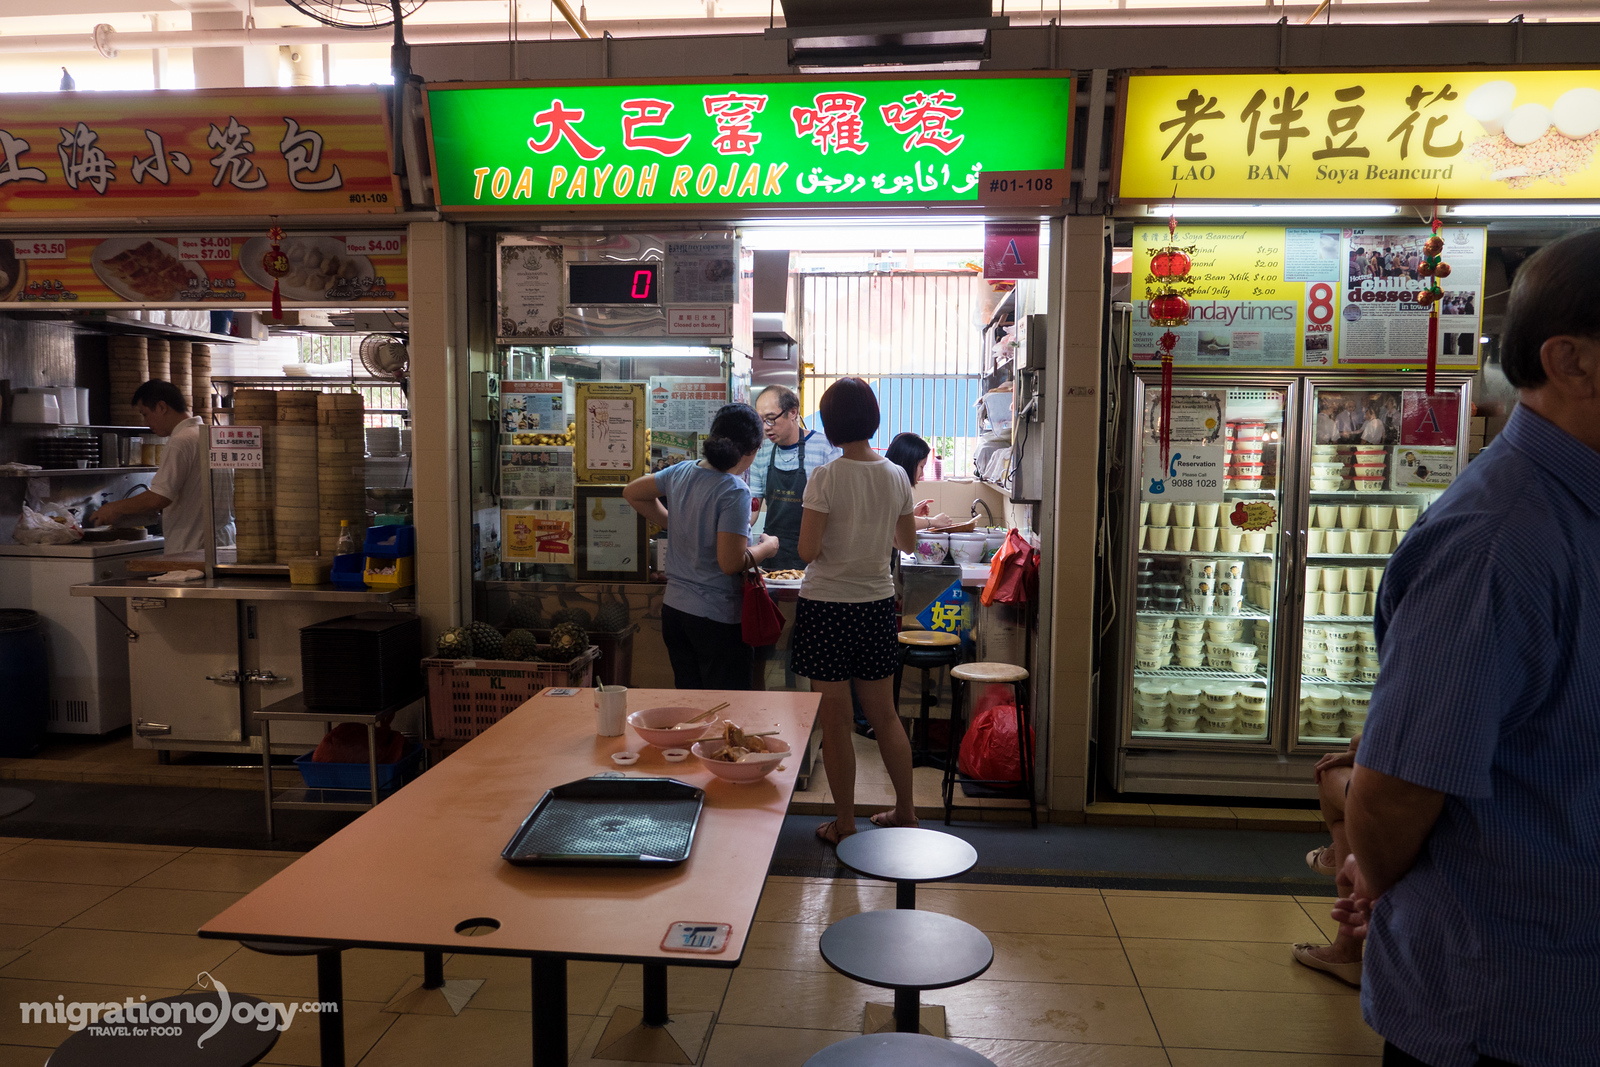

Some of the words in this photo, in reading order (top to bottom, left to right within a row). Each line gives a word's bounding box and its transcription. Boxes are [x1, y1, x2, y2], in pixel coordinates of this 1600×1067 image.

[1159, 83, 1464, 163] 老伴豆花
[1171, 165, 1216, 181] LAO
[1246, 165, 1291, 180] BAN
[1315, 164, 1359, 184] Soya
[1364, 164, 1453, 181] Beancurd
[474, 166, 533, 200] TOA
[548, 163, 659, 199] PAYOH
[670, 161, 789, 197] ROJAK
[989, 178, 1053, 193] #01-108
[348, 194, 388, 204] #01-109
[182, 240, 198, 248] 5pcs
[200, 237, 230, 248] $4.00
[1182, 232, 1203, 244] Soya
[1206, 231, 1247, 241] Beancurd
[15, 247, 31, 255] 5pcs
[33, 243, 64, 254] $3.50
[347, 244, 366, 252] 10pcs
[368, 240, 399, 251] $4.00
[997, 238, 1025, 265] A
[1256, 246, 1279, 255] $1.50
[180, 252, 198, 260] 10pcs
[201, 249, 230, 259] $7.00
[1254, 260, 1278, 268] $2.00
[1204, 273, 1225, 281] Bean
[1229, 272, 1250, 282] Milk
[1350, 273, 1373, 282] Hottest
[1361, 276, 1432, 290] chilled
[631, 270, 652, 299] 0
[205, 290, 246, 300] Dumpling
[353, 289, 396, 299] Dumpling
[1212, 286, 1231, 298] Jelly
[1252, 287, 1275, 296] $3.00
[1307, 282, 1334, 325] 8
[1307, 324, 1333, 332] DAYS
[1415, 407, 1443, 433] A
[1171, 480, 1193, 488] 9088
[1196, 480, 1217, 488] 1028
[490, 676, 506, 690] KL
